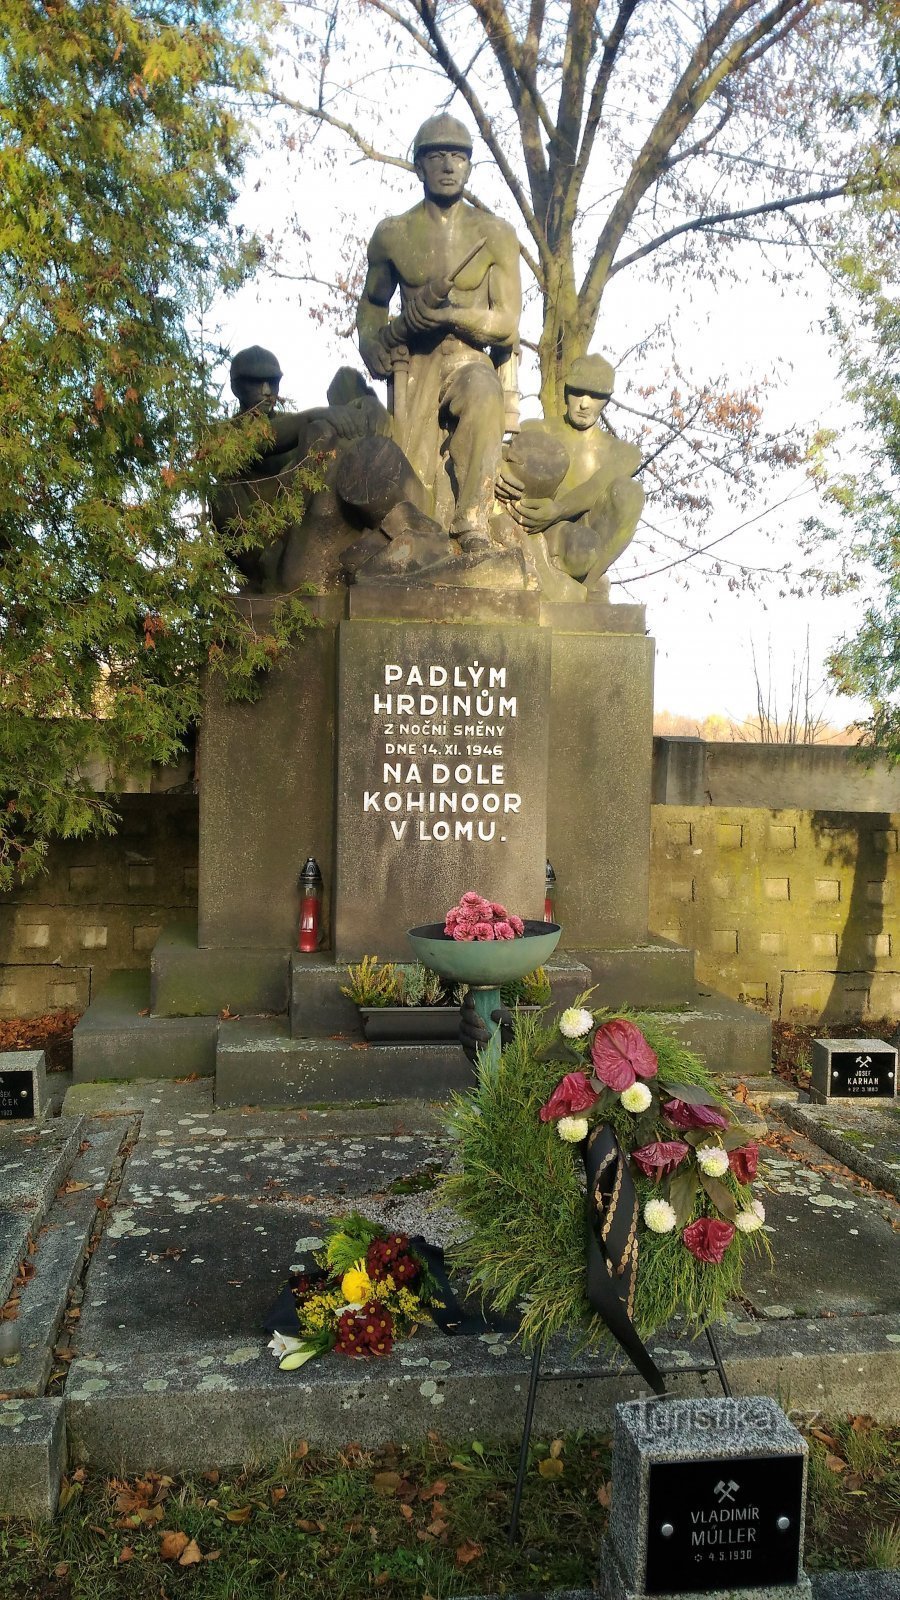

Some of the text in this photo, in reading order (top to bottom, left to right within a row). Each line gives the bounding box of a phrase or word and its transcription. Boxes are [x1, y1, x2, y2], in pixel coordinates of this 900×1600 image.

[373, 689, 517, 717] HRDINŮM
[384, 720, 505, 737] Z NOČNÍ SMĚNY
[385, 743, 416, 755] DNE
[466, 745, 503, 756] 1946
[383, 763, 505, 785] NA DOLE
[363, 791, 522, 813] KOHINOOR
[390, 820, 507, 842] V LOMU.
[847, 1077, 879, 1085] KARHAN
[690, 1504, 760, 1524] VLADIMÍR
